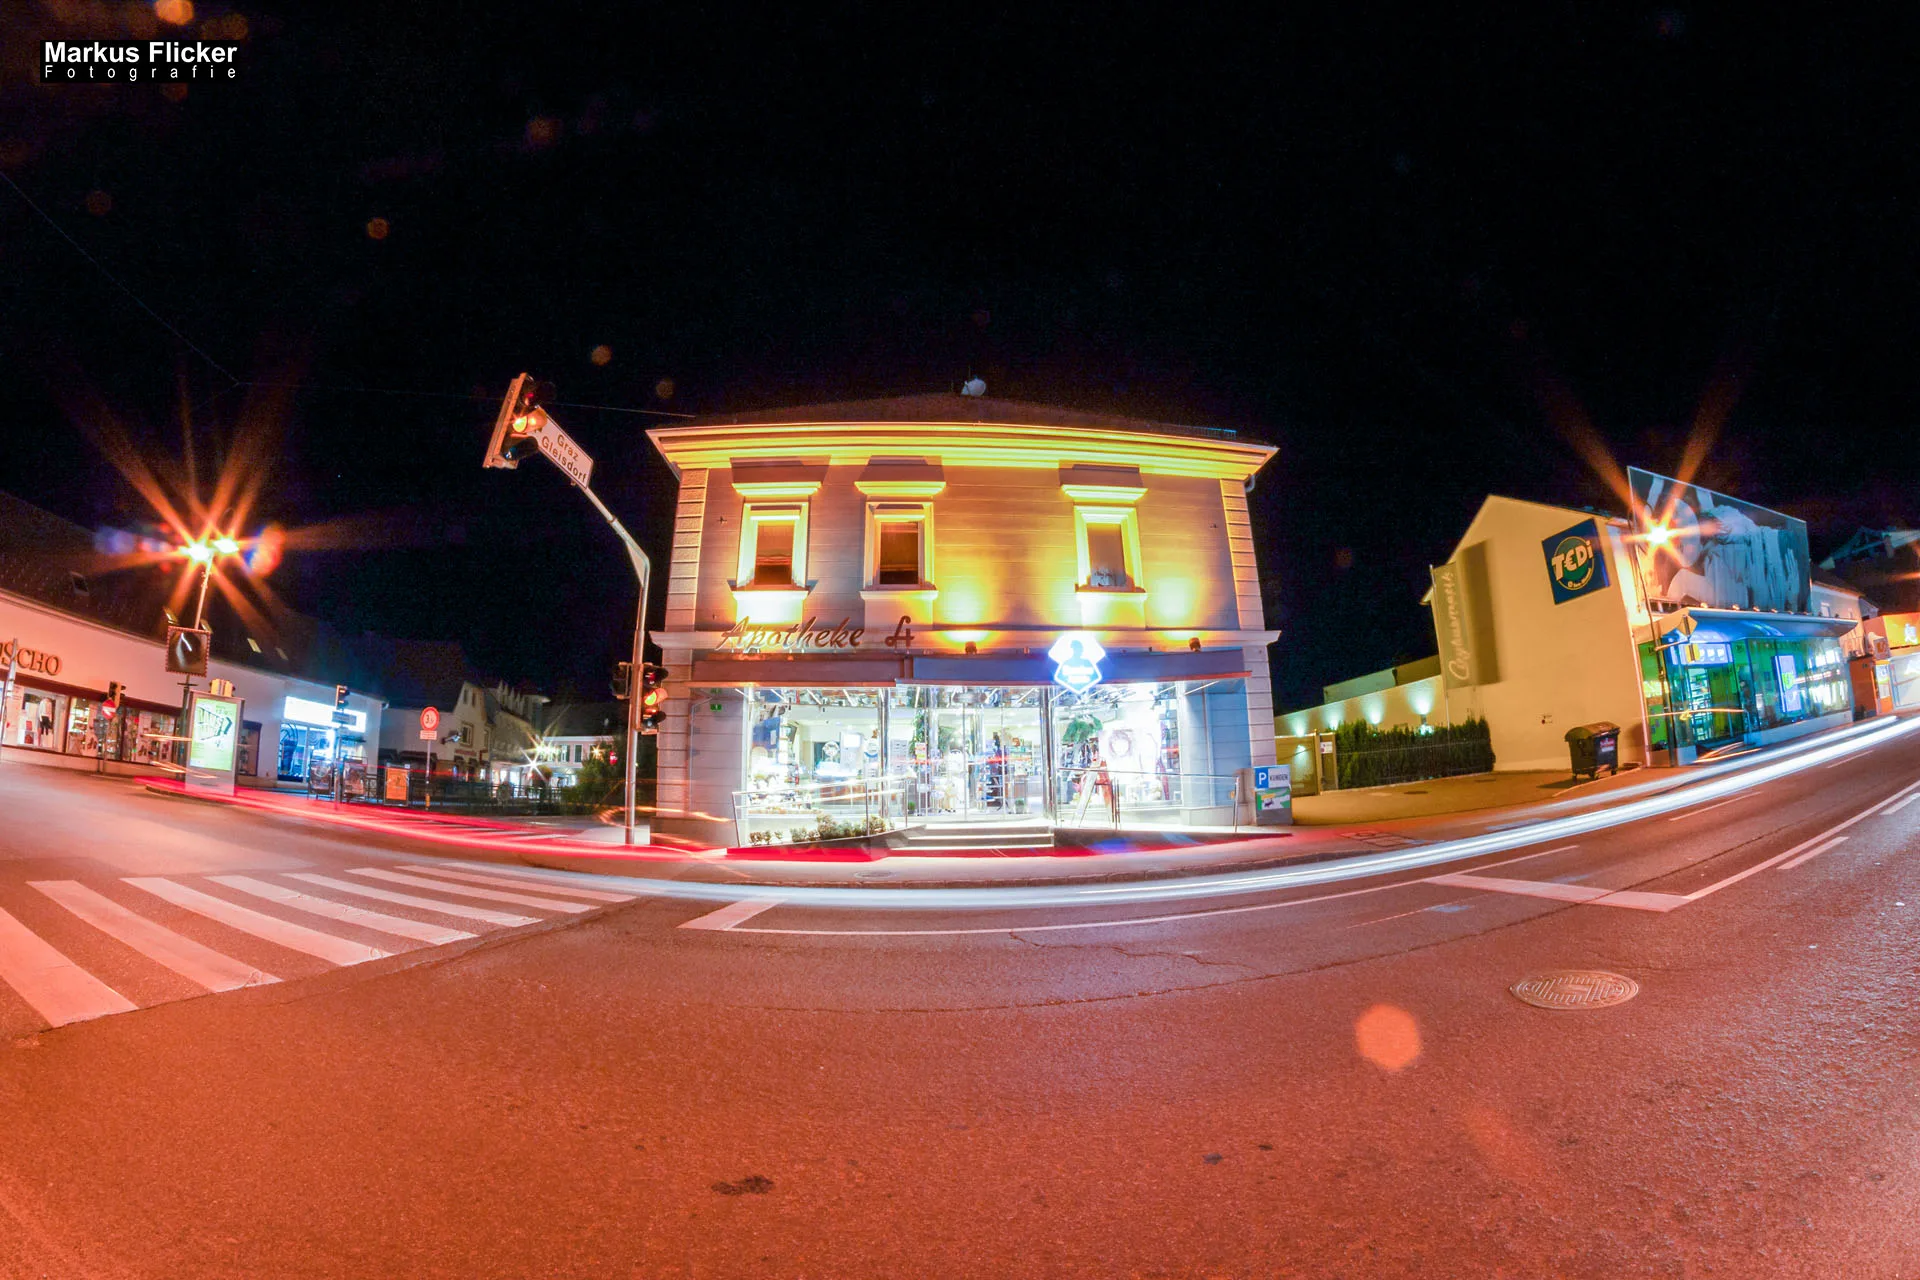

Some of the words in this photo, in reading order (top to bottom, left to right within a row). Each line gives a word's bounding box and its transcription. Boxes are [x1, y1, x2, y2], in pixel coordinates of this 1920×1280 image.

[541, 436, 587, 482] Gleisdorf
[557, 434, 579, 461] Graz
[715, 616, 864, 652] Apotheke
[1258, 772, 1267, 785] P
